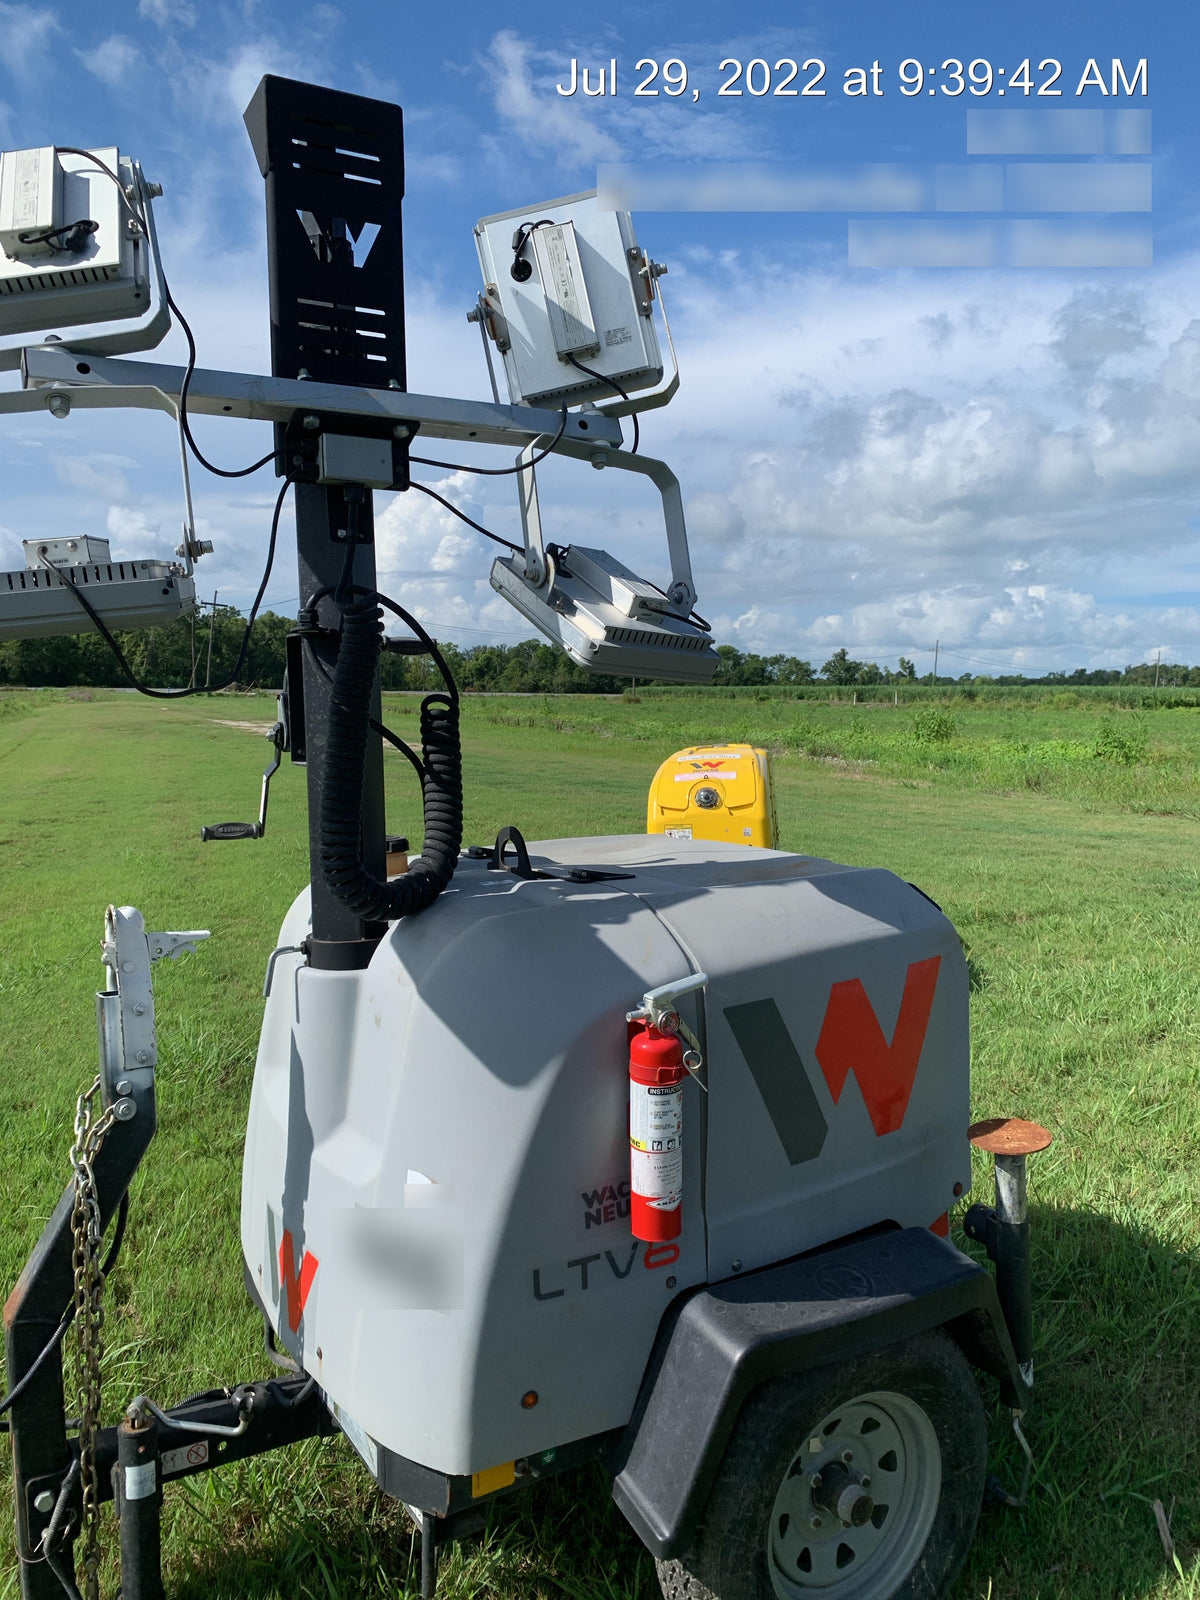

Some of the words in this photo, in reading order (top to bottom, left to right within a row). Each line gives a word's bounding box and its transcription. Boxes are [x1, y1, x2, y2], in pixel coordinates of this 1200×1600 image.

[649, 1085, 681, 1096] INSTRUC
[581, 1180, 632, 1210] WAC
[585, 1200, 632, 1230] NEU
